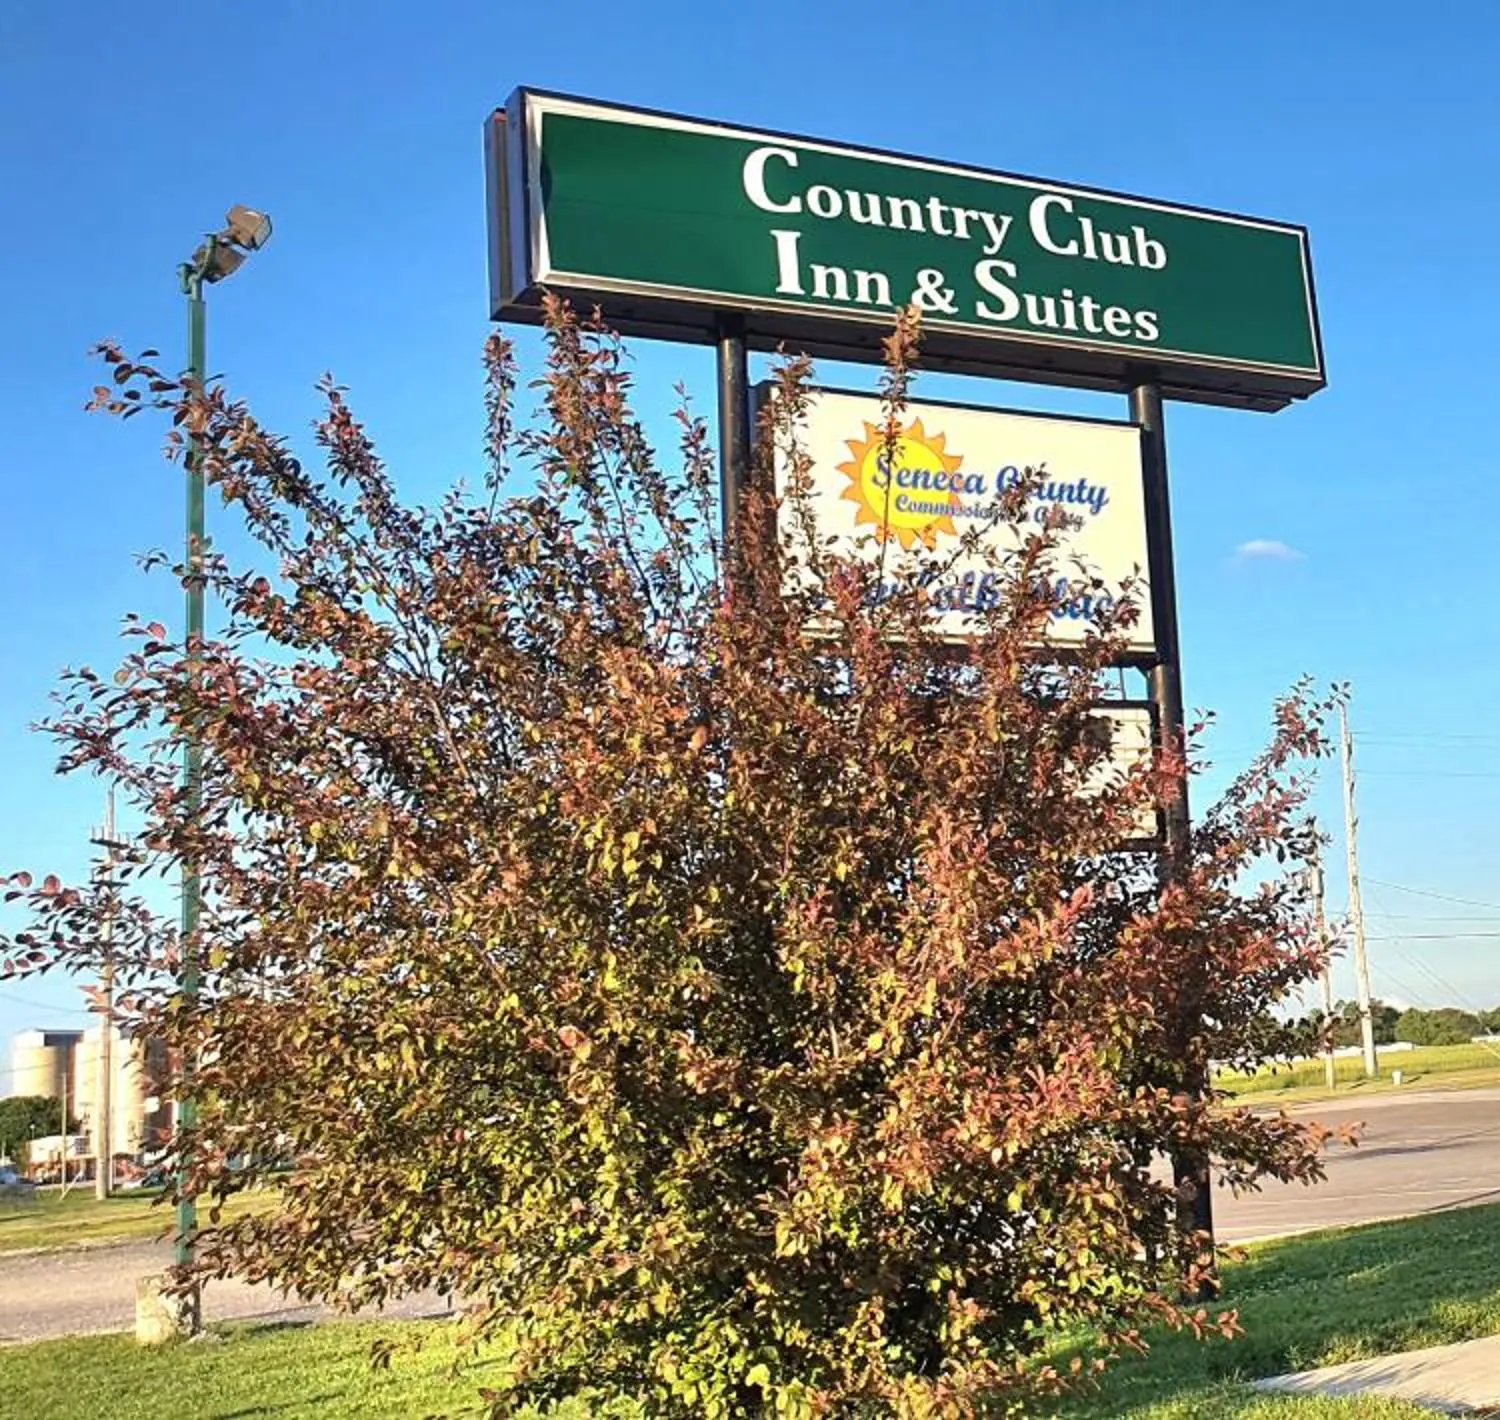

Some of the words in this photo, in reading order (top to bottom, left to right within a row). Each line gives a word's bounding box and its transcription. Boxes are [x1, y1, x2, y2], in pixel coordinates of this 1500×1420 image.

[742, 146, 1013, 253] Country
[1030, 194, 1168, 270] Club
[770, 229, 891, 306] Inn
[911, 269, 957, 313] &
[975, 259, 1160, 342] Suites
[872, 454, 988, 495] Seneca
[996, 465, 1109, 516] Cunty
